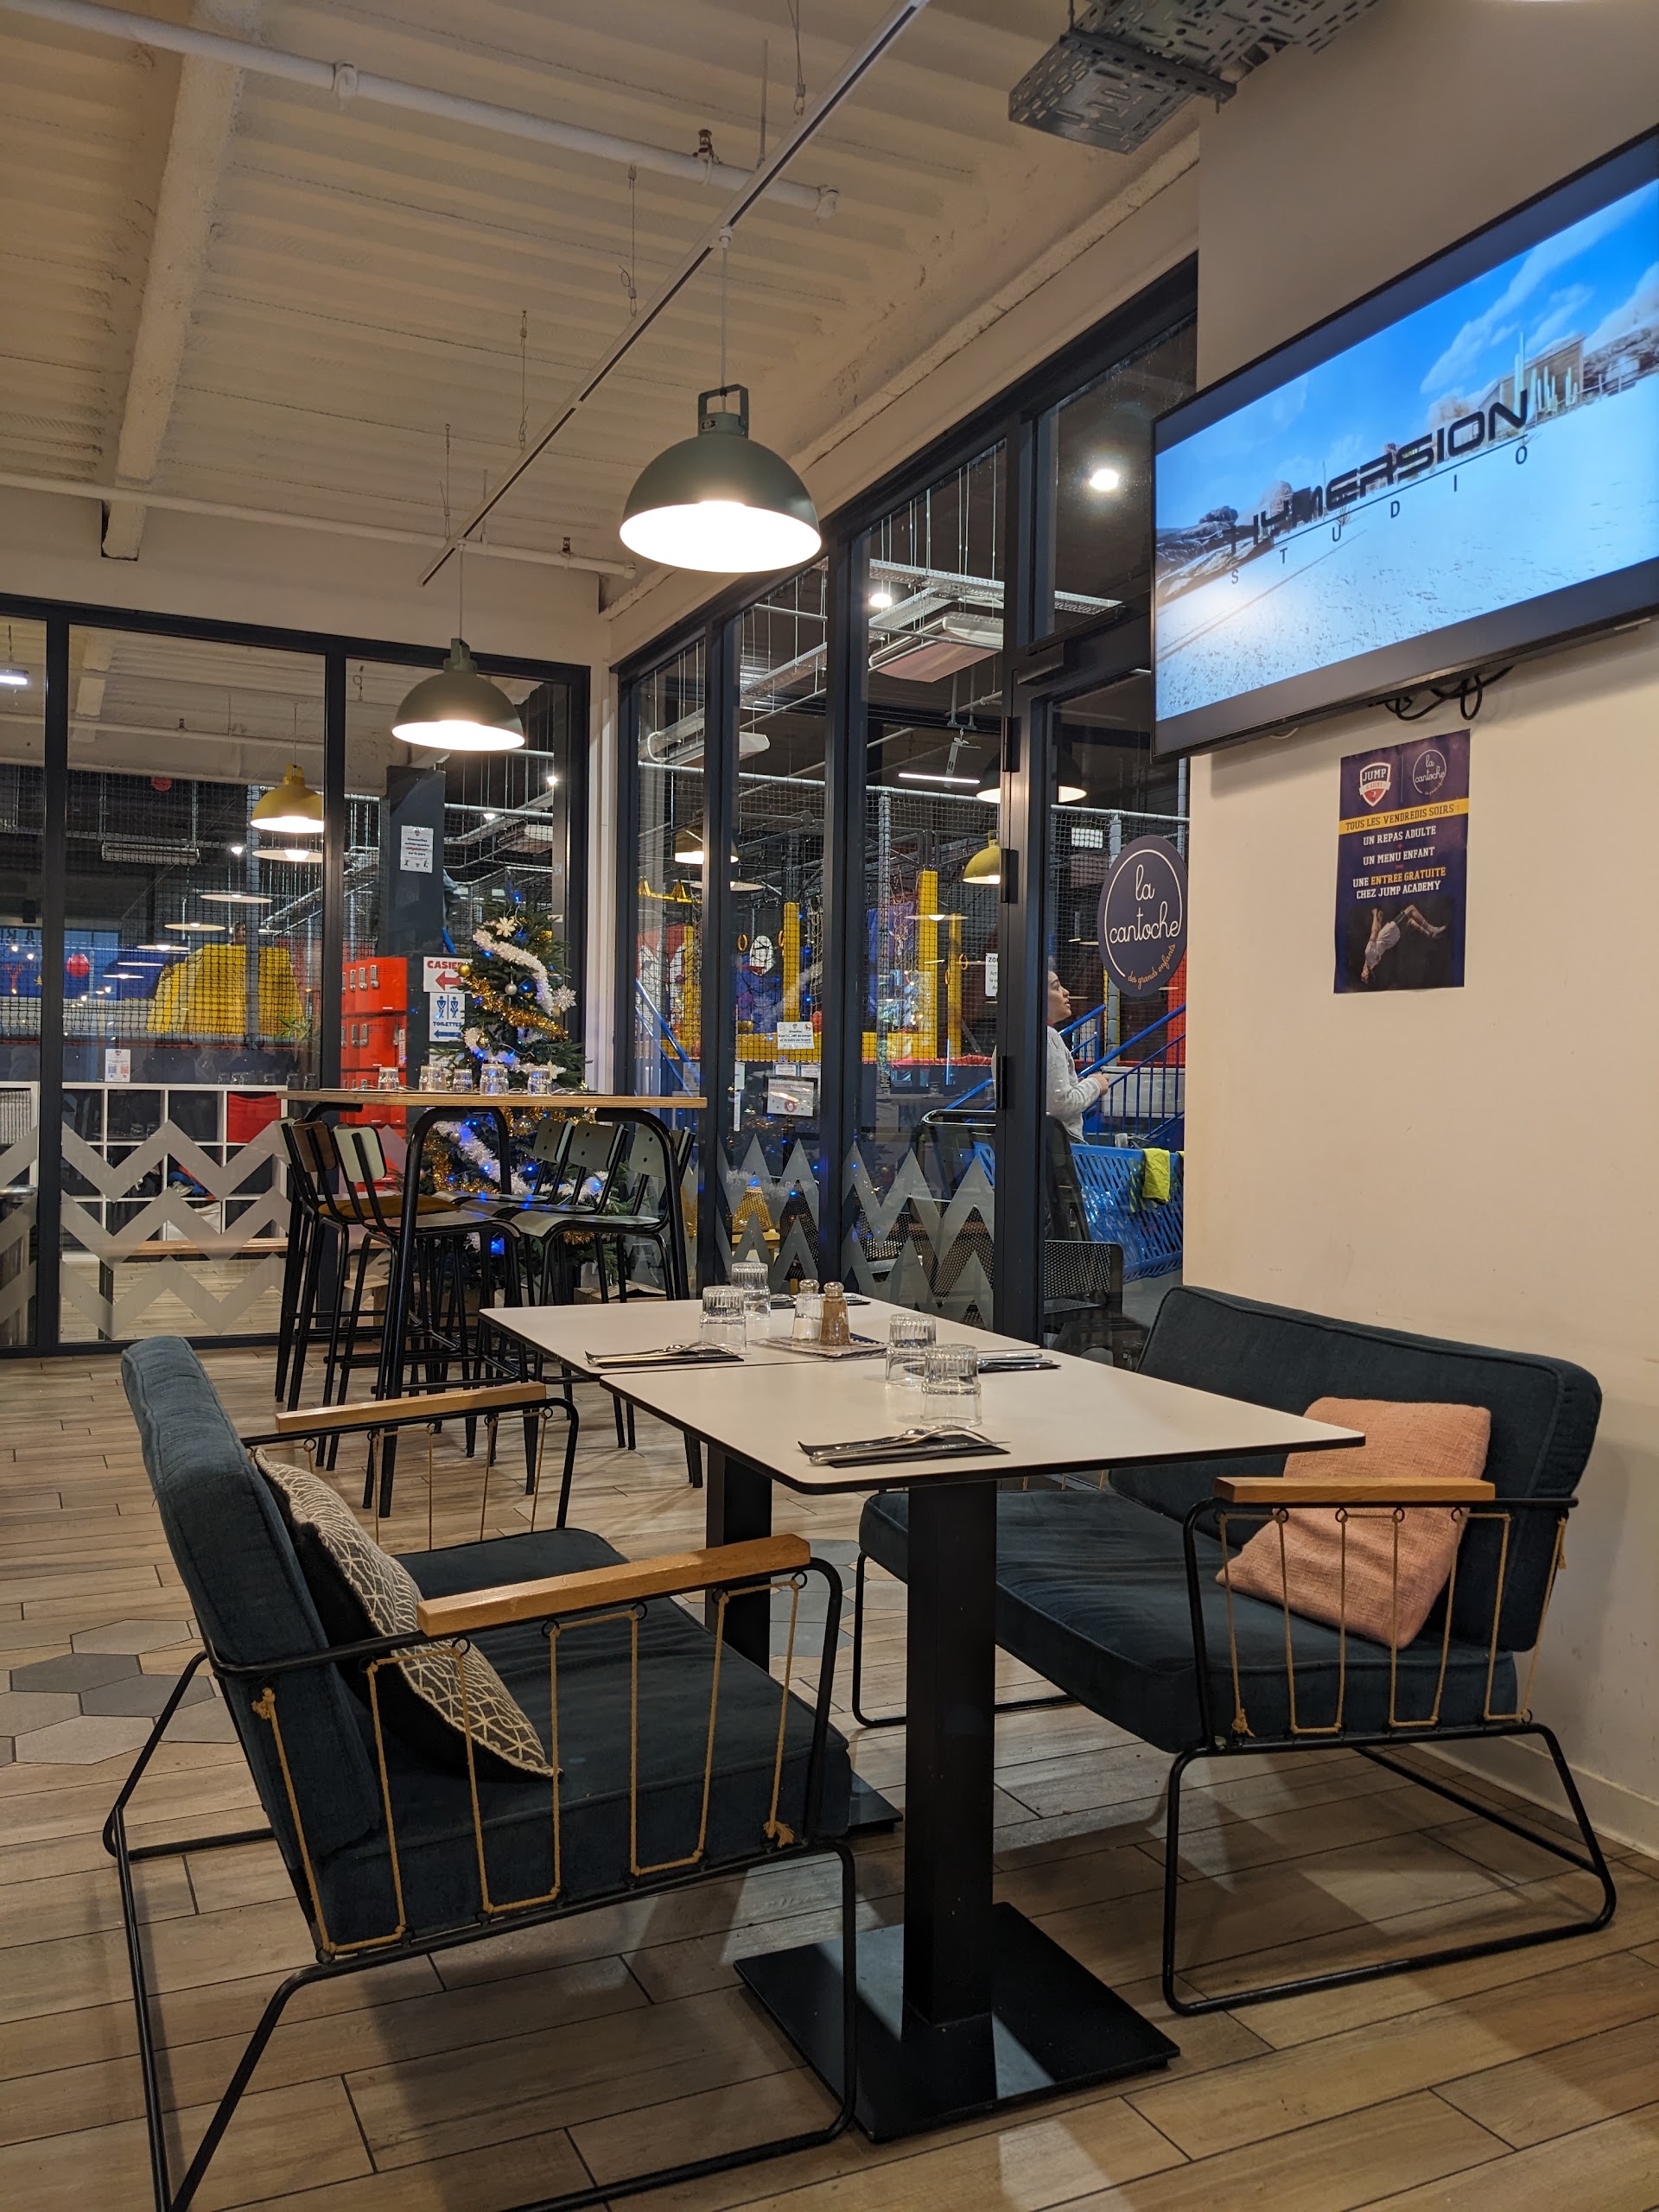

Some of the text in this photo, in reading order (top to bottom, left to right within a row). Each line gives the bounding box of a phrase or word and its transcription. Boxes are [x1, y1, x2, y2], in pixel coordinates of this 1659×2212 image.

[1231, 445, 1528, 585] STUDIO
[1425, 754, 1434, 768] la
[1363, 768, 1387, 782] JUMP
[1414, 766, 1446, 783] cantoche
[1345, 819, 1365, 831] TOUS
[1366, 817, 1381, 827] LES
[1382, 808, 1427, 824] VENDREDIS
[1428, 804, 1454, 817] SOIRS
[1363, 825, 1437, 846] UN REPAS ADULTE
[1363, 846, 1435, 866] UN MENU ENFANT
[1135, 864, 1155, 901] la
[1352, 867, 1446, 888] UNE ENTREE GRATUITE
[1356, 880, 1441, 899] CHEZ JUMP ACADEMY
[1109, 900, 1179, 944] cantoche
[1128, 943, 1176, 990] des grands enfants
